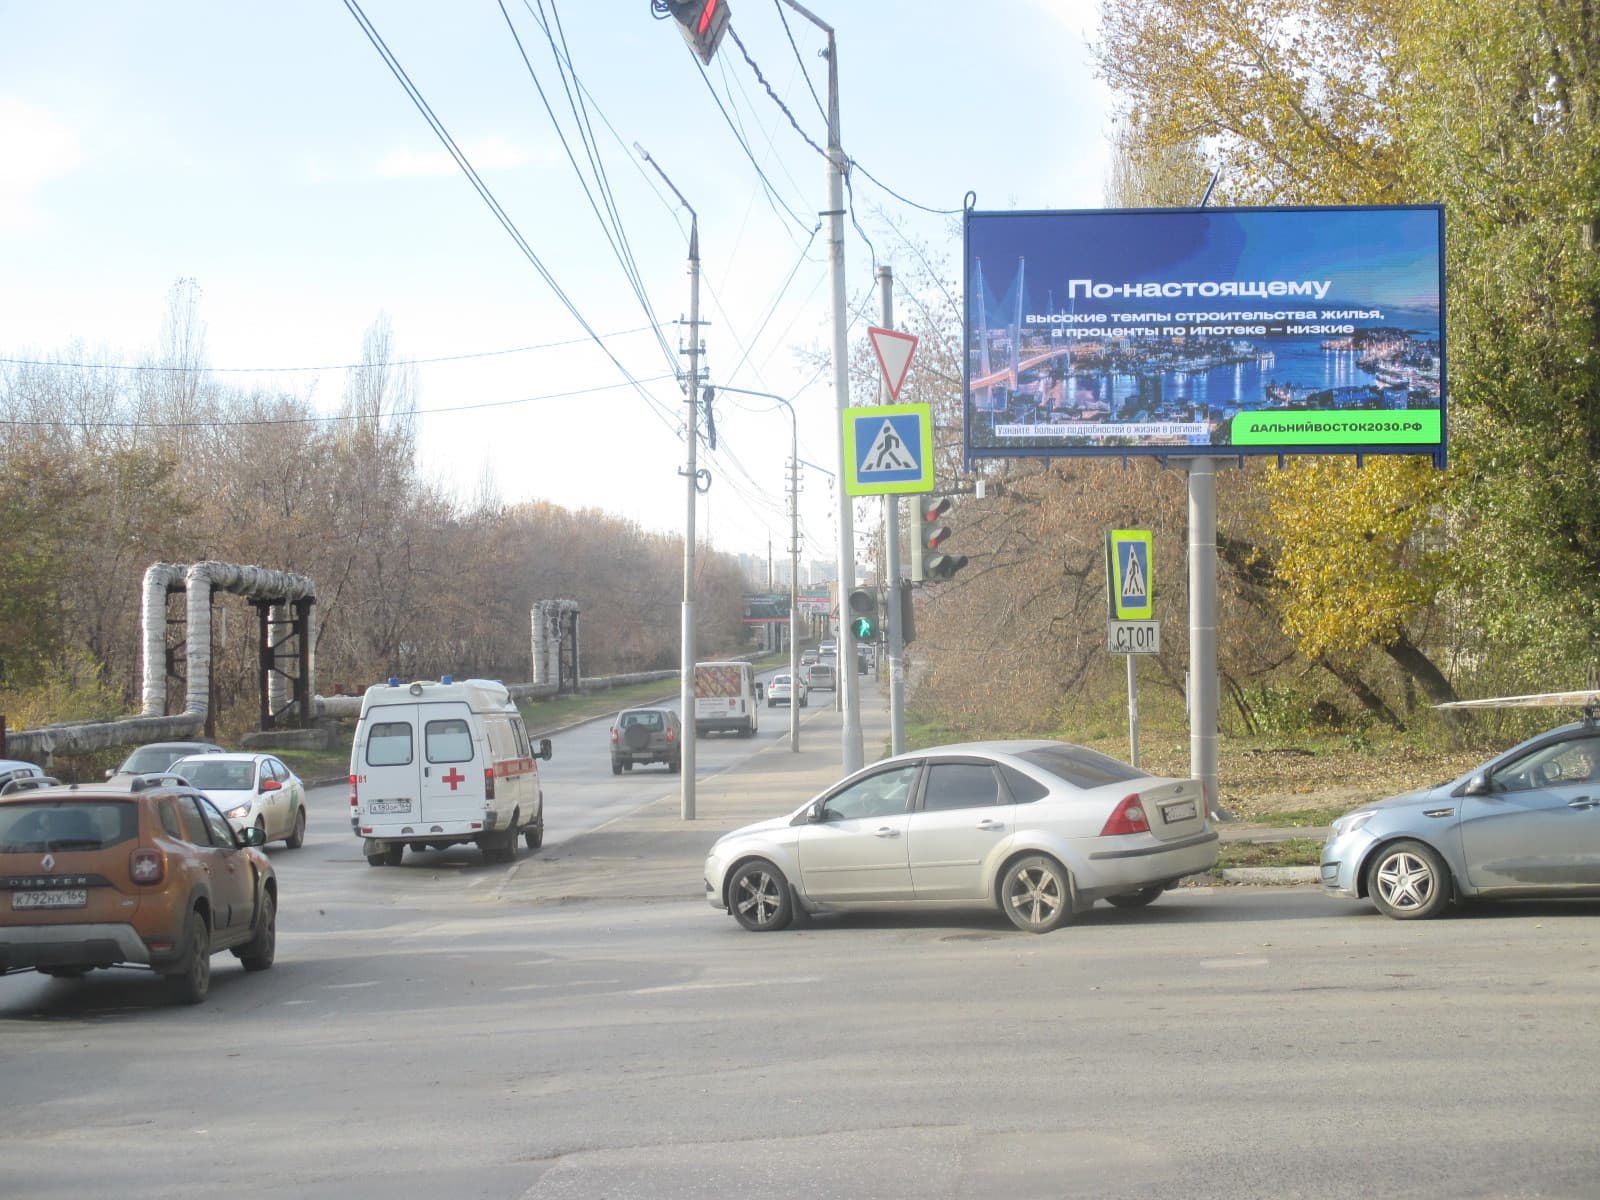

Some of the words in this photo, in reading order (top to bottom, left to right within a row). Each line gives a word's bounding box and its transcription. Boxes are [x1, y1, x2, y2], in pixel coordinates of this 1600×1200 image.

[1068, 279, 1332, 300] По-настоящему
[1025, 312, 1108, 324] высокие
[1111, 312, 1171, 322] темпы
[1175, 310, 1317, 324] строительства
[1320, 309, 1385, 321] жилья,
[1051, 328, 1063, 338] а
[1066, 326, 1159, 339] проценты
[1162, 326, 1185, 336] по
[1189, 325, 1267, 335] ипотеке
[1286, 323, 1355, 334] низкие
[1250, 421, 1423, 433] ДАЛЬНИЙВОСТОК2030.РФ
[1116, 626, 1154, 647] СТОП
